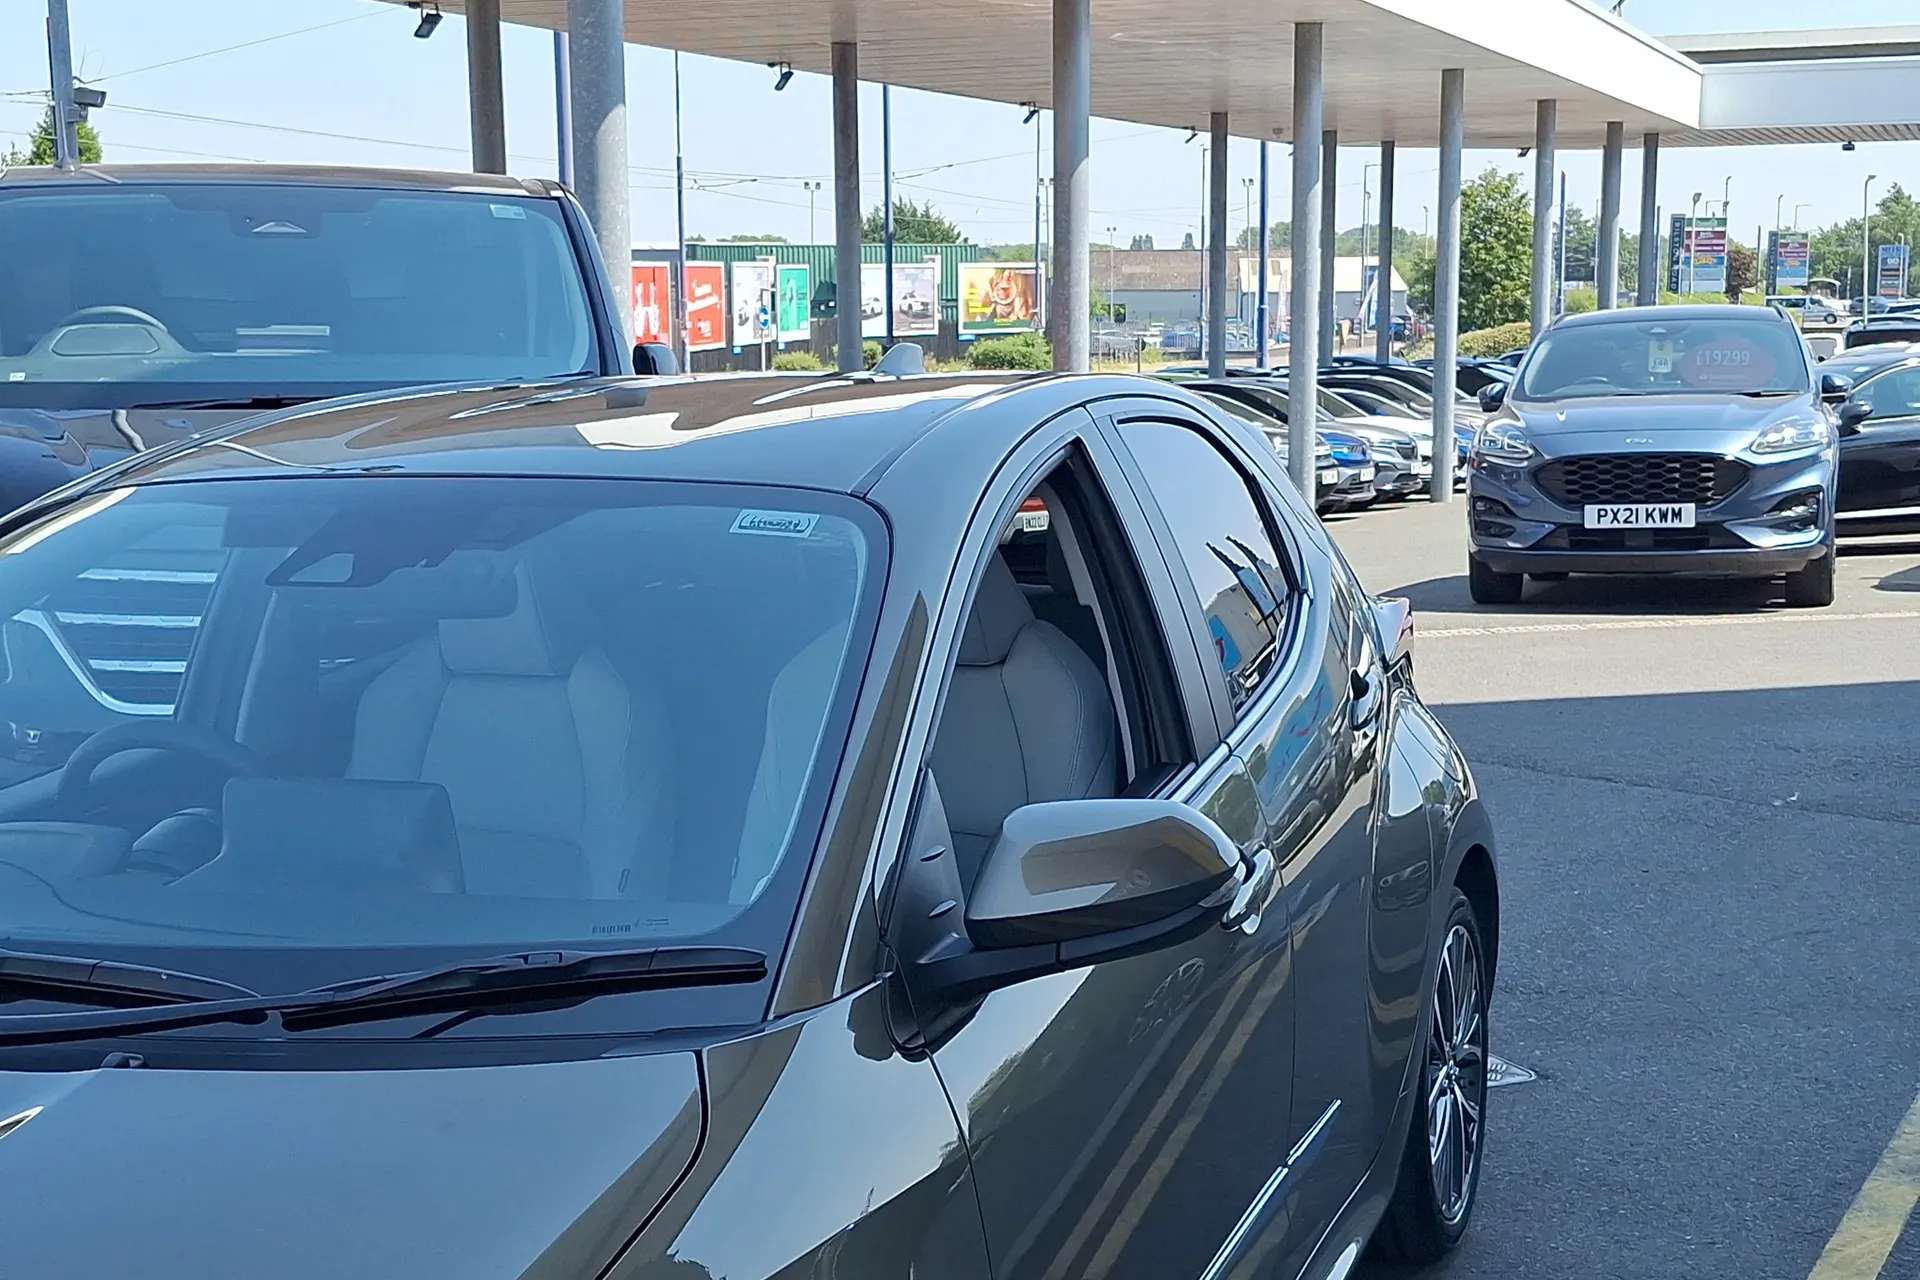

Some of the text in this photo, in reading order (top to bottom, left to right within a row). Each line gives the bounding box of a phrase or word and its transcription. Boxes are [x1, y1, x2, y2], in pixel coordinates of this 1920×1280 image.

[1673, 221, 1681, 262] BILSTON
[1597, 507, 1682, 524] PX21 KWM
